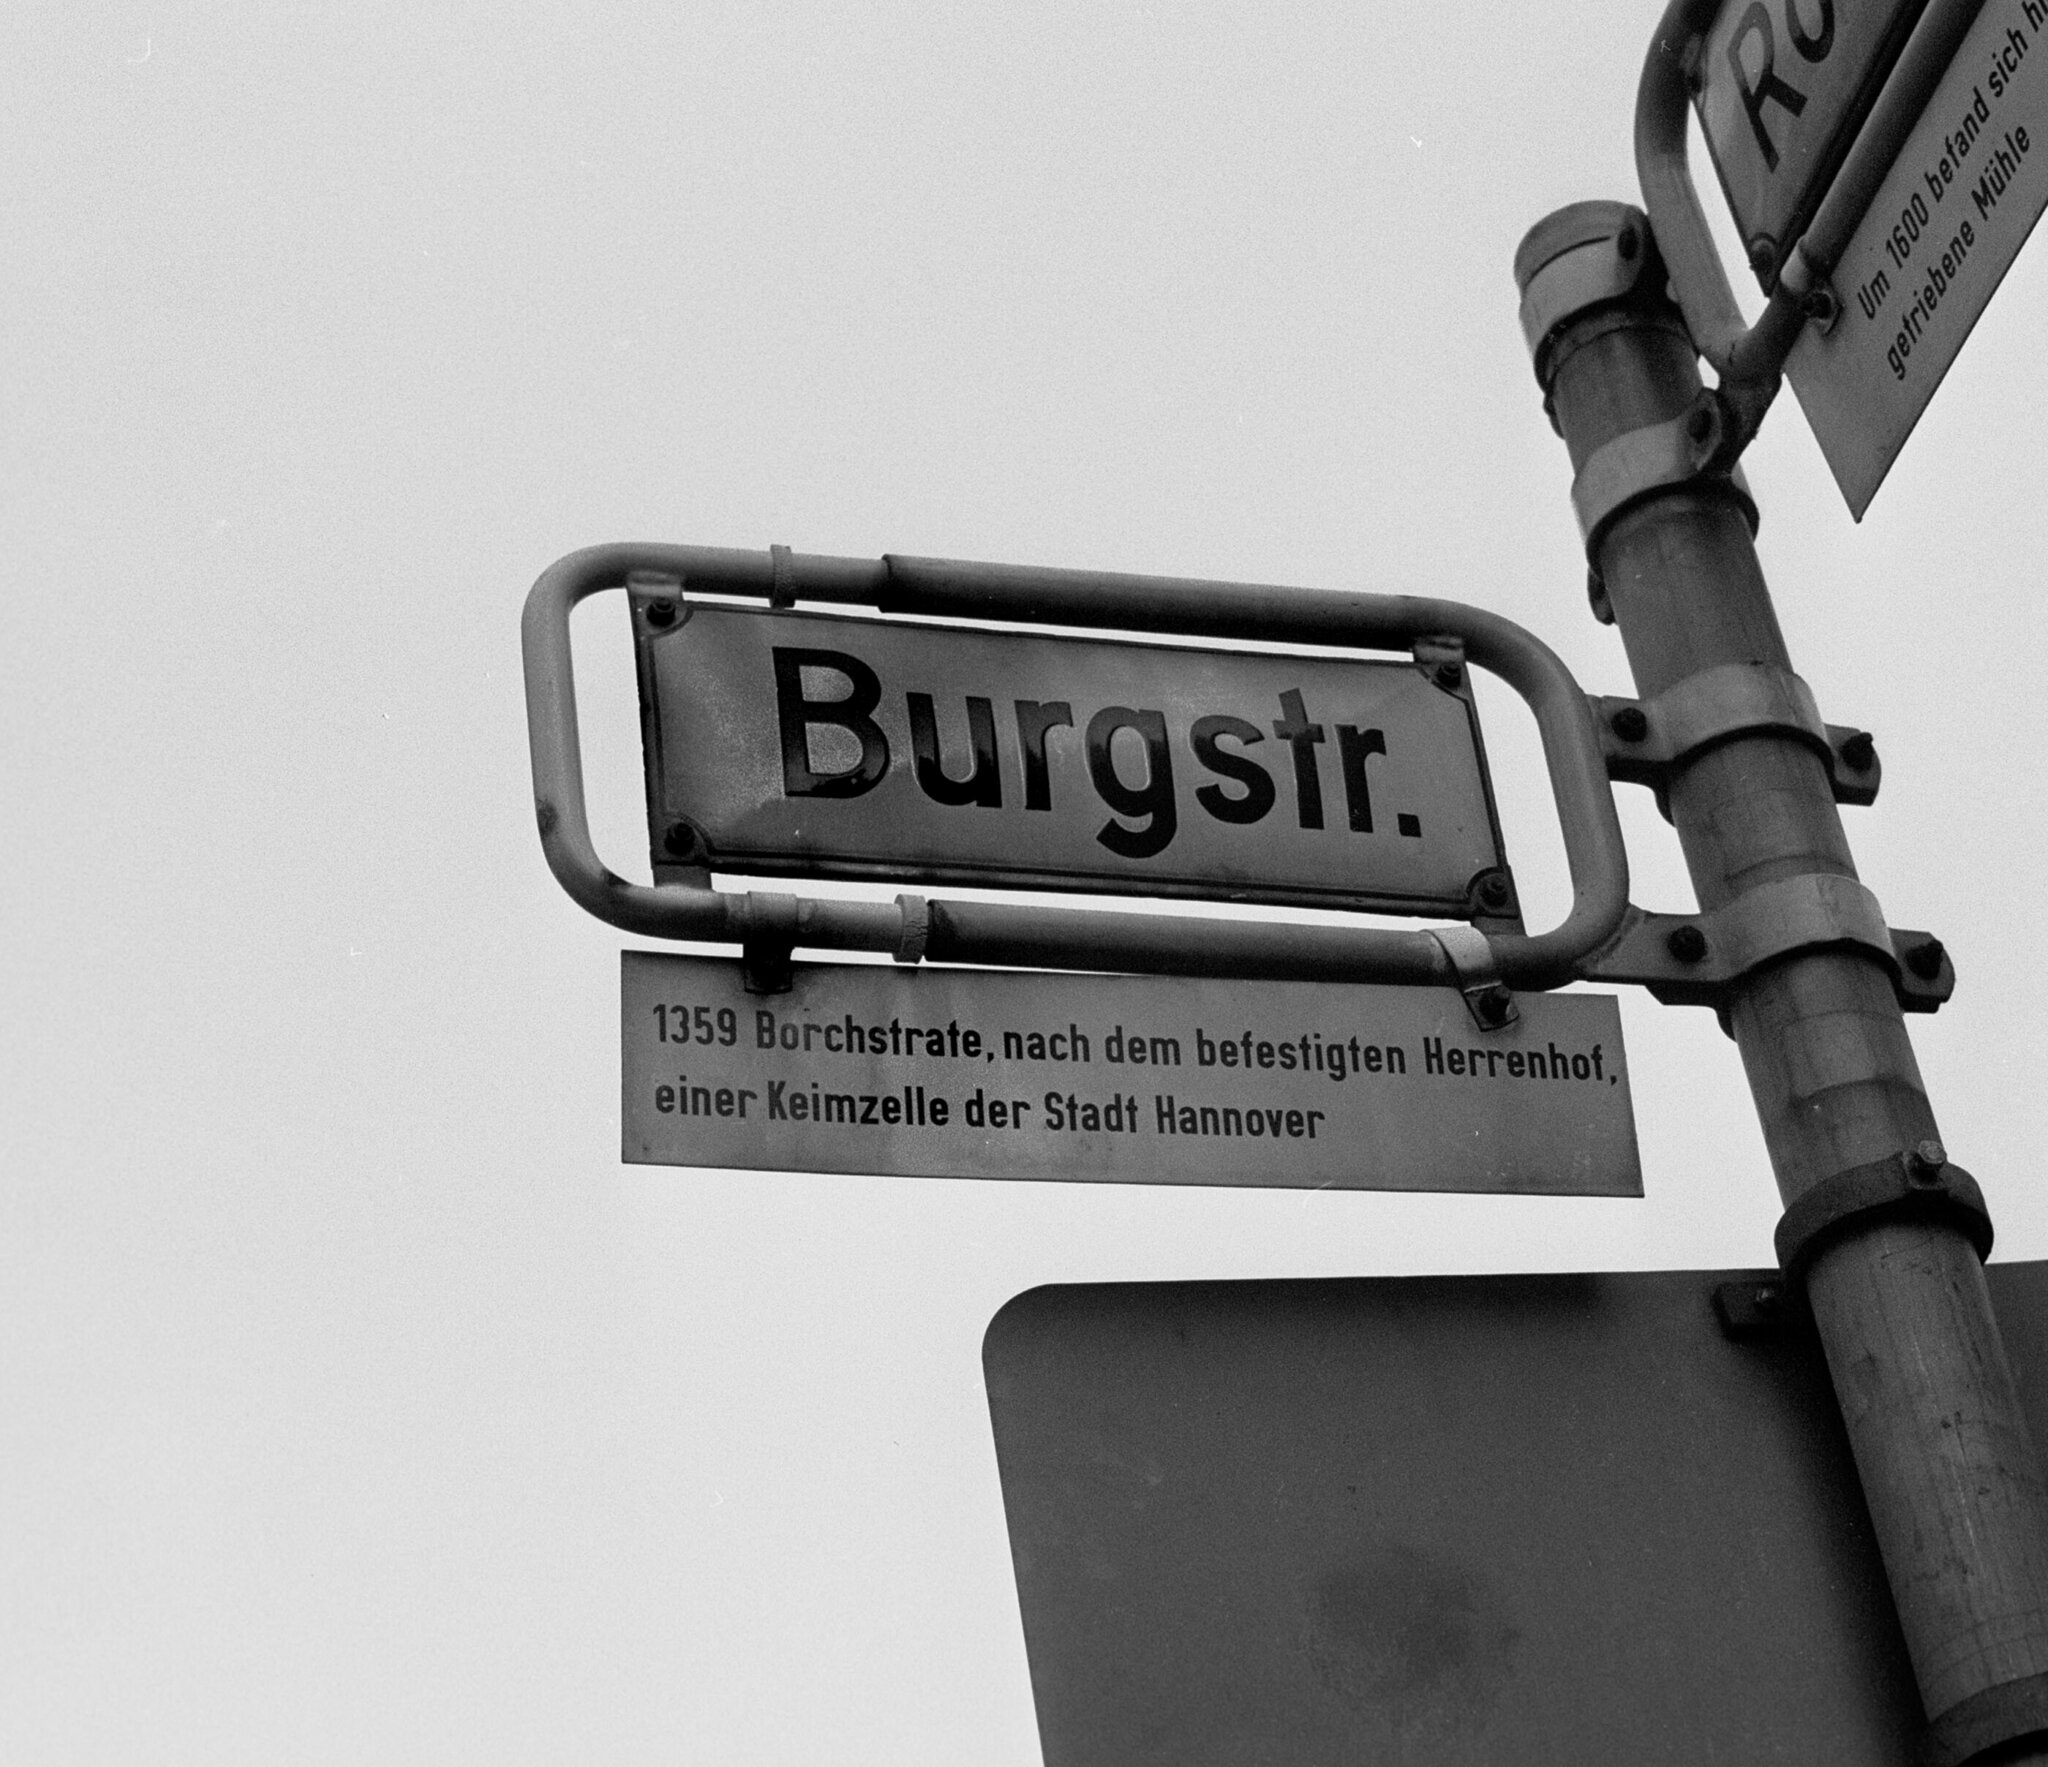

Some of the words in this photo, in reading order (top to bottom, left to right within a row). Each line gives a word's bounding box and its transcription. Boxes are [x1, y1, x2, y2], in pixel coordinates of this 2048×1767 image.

[1857, 269, 1891, 321] Um
[1885, 192, 1929, 269] 1600
[1924, 85, 1992, 203] befand
[1988, 27, 2028, 98] sich
[1886, 220, 1975, 381] getriebene
[1970, 125, 2031, 222] Mühle
[771, 645, 1423, 860] Burgstr.
[652, 1003, 738, 1047] 1359
[755, 1009, 995, 1064] Borchstrate,
[1003, 1023, 1091, 1064] nach
[1104, 1025, 1182, 1066] dem
[1195, 1027, 1407, 1082] befestigten
[1422, 1036, 1618, 1087] Herrenhof,
[655, 1075, 757, 1118] einer
[767, 1079, 950, 1127] Keimzelle
[964, 1088, 1031, 1130] der
[1043, 1090, 1139, 1134] Stadt
[1155, 1095, 1326, 1139] Hannover
